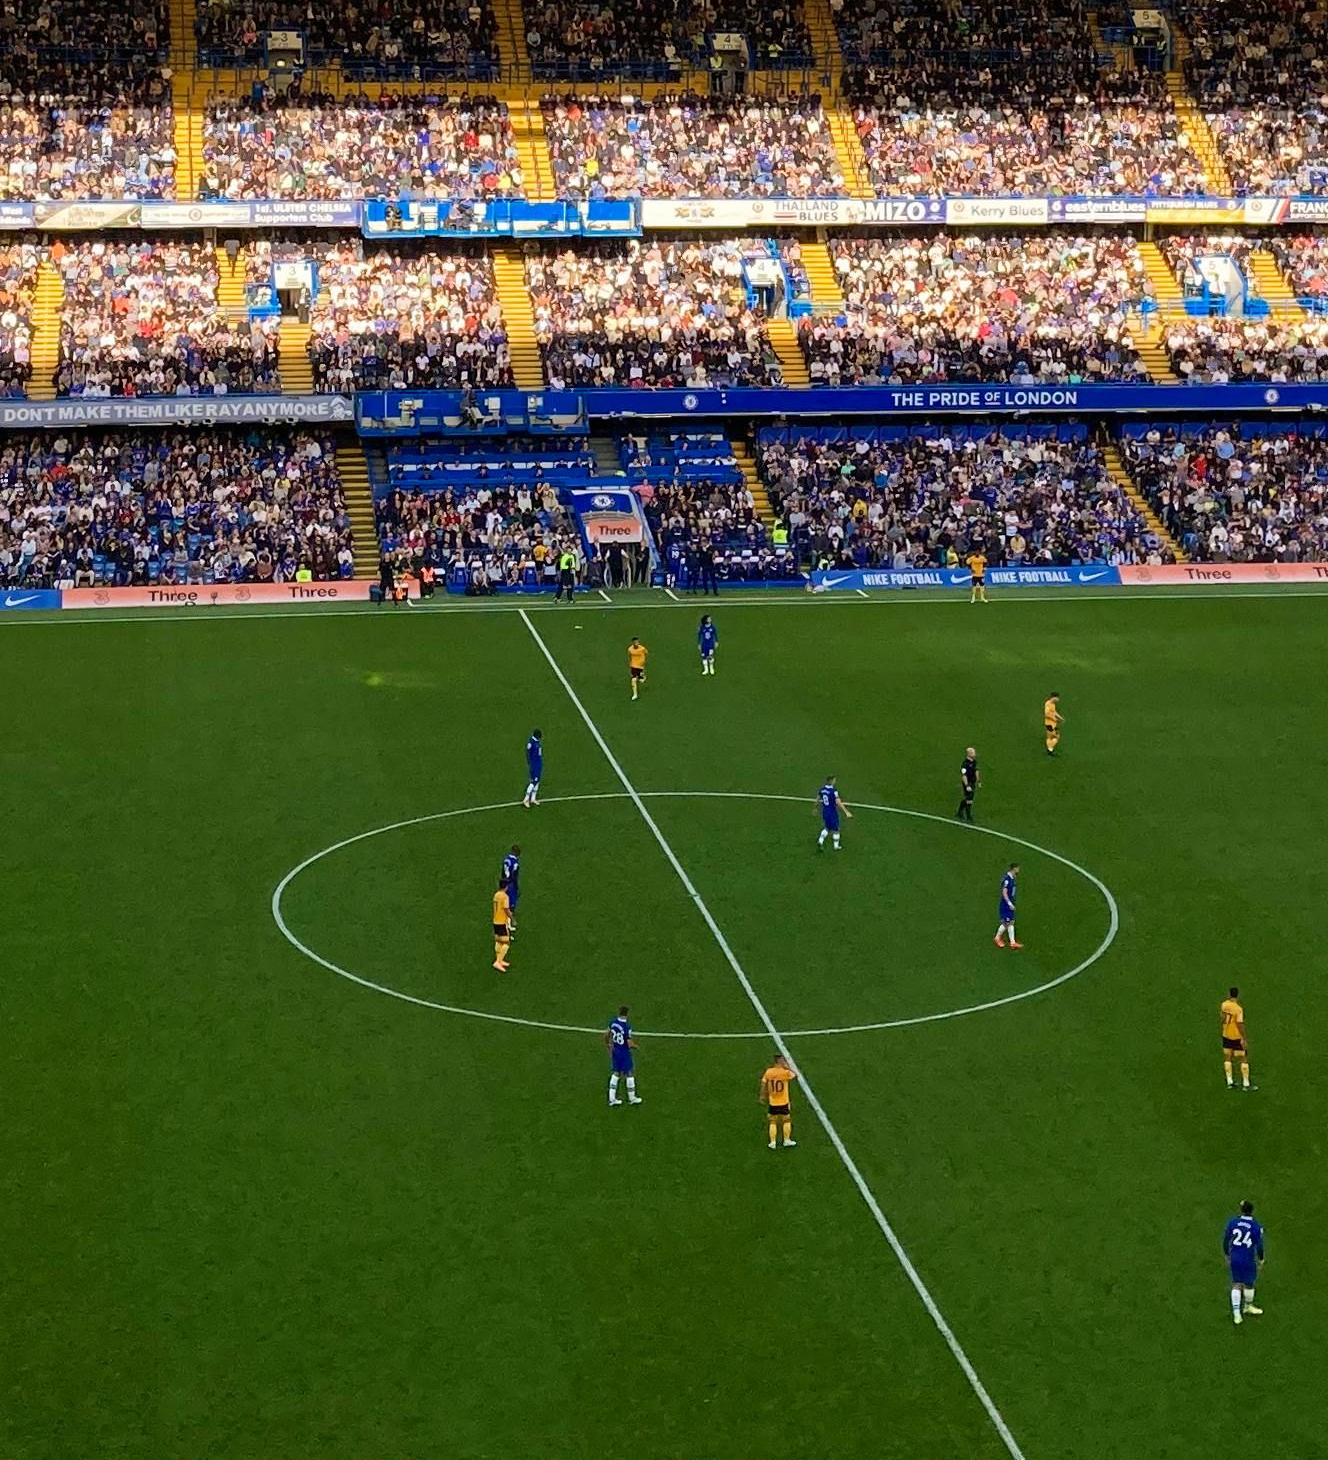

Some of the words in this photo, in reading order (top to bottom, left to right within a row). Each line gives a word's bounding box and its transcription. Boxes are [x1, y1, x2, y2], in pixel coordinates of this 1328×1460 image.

[308, 202, 352, 213] CHELSEA
[773, 200, 839, 211] THAILAND
[864, 200, 926, 221] MIZO
[970, 205, 1005, 220] Kerry
[1009, 204, 1045, 217] Blues
[254, 213, 308, 224] Supporters
[310, 213, 334, 223] Club
[799, 211, 839, 222] BLUES
[891, 393, 924, 406] THE
[929, 392, 981, 406] PRIDE
[984, 392, 1001, 402] OF
[1005, 391, 1078, 405] LONDON
[4, 407, 56, 422] DON'T
[58, 405, 112, 420] MAKE
[114, 404, 163, 419] THEM
[165, 404, 203, 417] LIKE
[205, 403, 242, 417] RAY
[242, 402, 329, 417] ANYMORE
[598, 525, 631, 536] Three
[863, 573, 889, 587] NIKE
[890, 572, 944, 585] FOOTBALL
[991, 571, 1018, 584] NIKE
[1019, 570, 1072, 583] FOOTBALL
[1184, 568, 1233, 580] Three
[148, 590, 198, 603] Three
[287, 585, 338, 599] Three
[611, 1028, 624, 1046] 28
[770, 1079, 784, 1094] 10
[1232, 1228, 1253, 1249] 24
